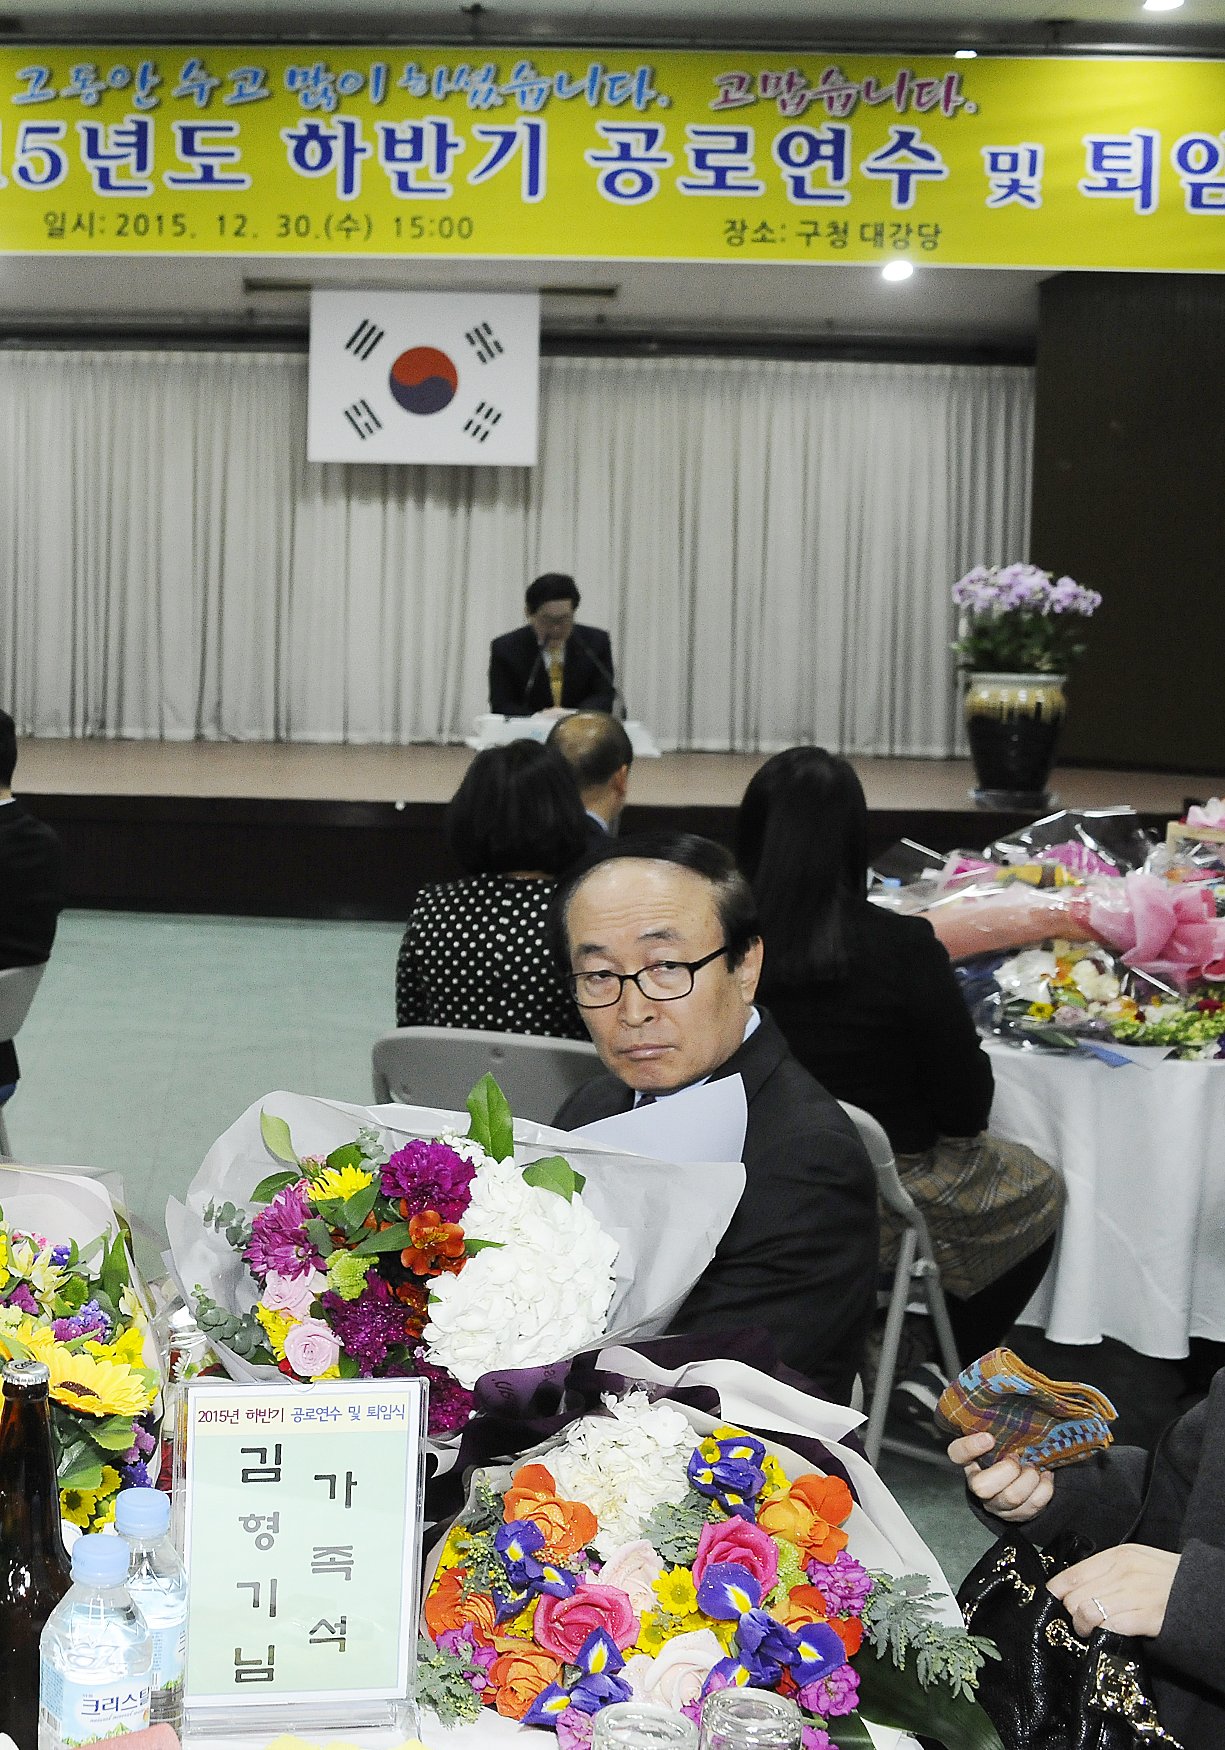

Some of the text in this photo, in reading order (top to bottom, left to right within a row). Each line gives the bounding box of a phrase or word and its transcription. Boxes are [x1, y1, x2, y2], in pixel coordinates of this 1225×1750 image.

[11, 60, 161, 109] 그동안
[171, 57, 271, 108] 수고
[283, 61, 387, 111] 많이
[709, 66, 977, 117] 고맙습니다.
[281, 113, 547, 205] 하반기
[585, 120, 950, 211] 공로연수
[980, 142, 1045, 209] 및
[115, 213, 197, 239] 2015.
[218, 213, 259, 239] 12.
[393, 215, 475, 240] 15:00
[723, 218, 943, 251] 장소: 구청 대강당
[198, 1403, 406, 1424] 2015년 하반기 공로연수 및 퇴임식
[234, 1443, 283, 1684] 김형기님
[308, 1471, 358, 1653] 가족석
